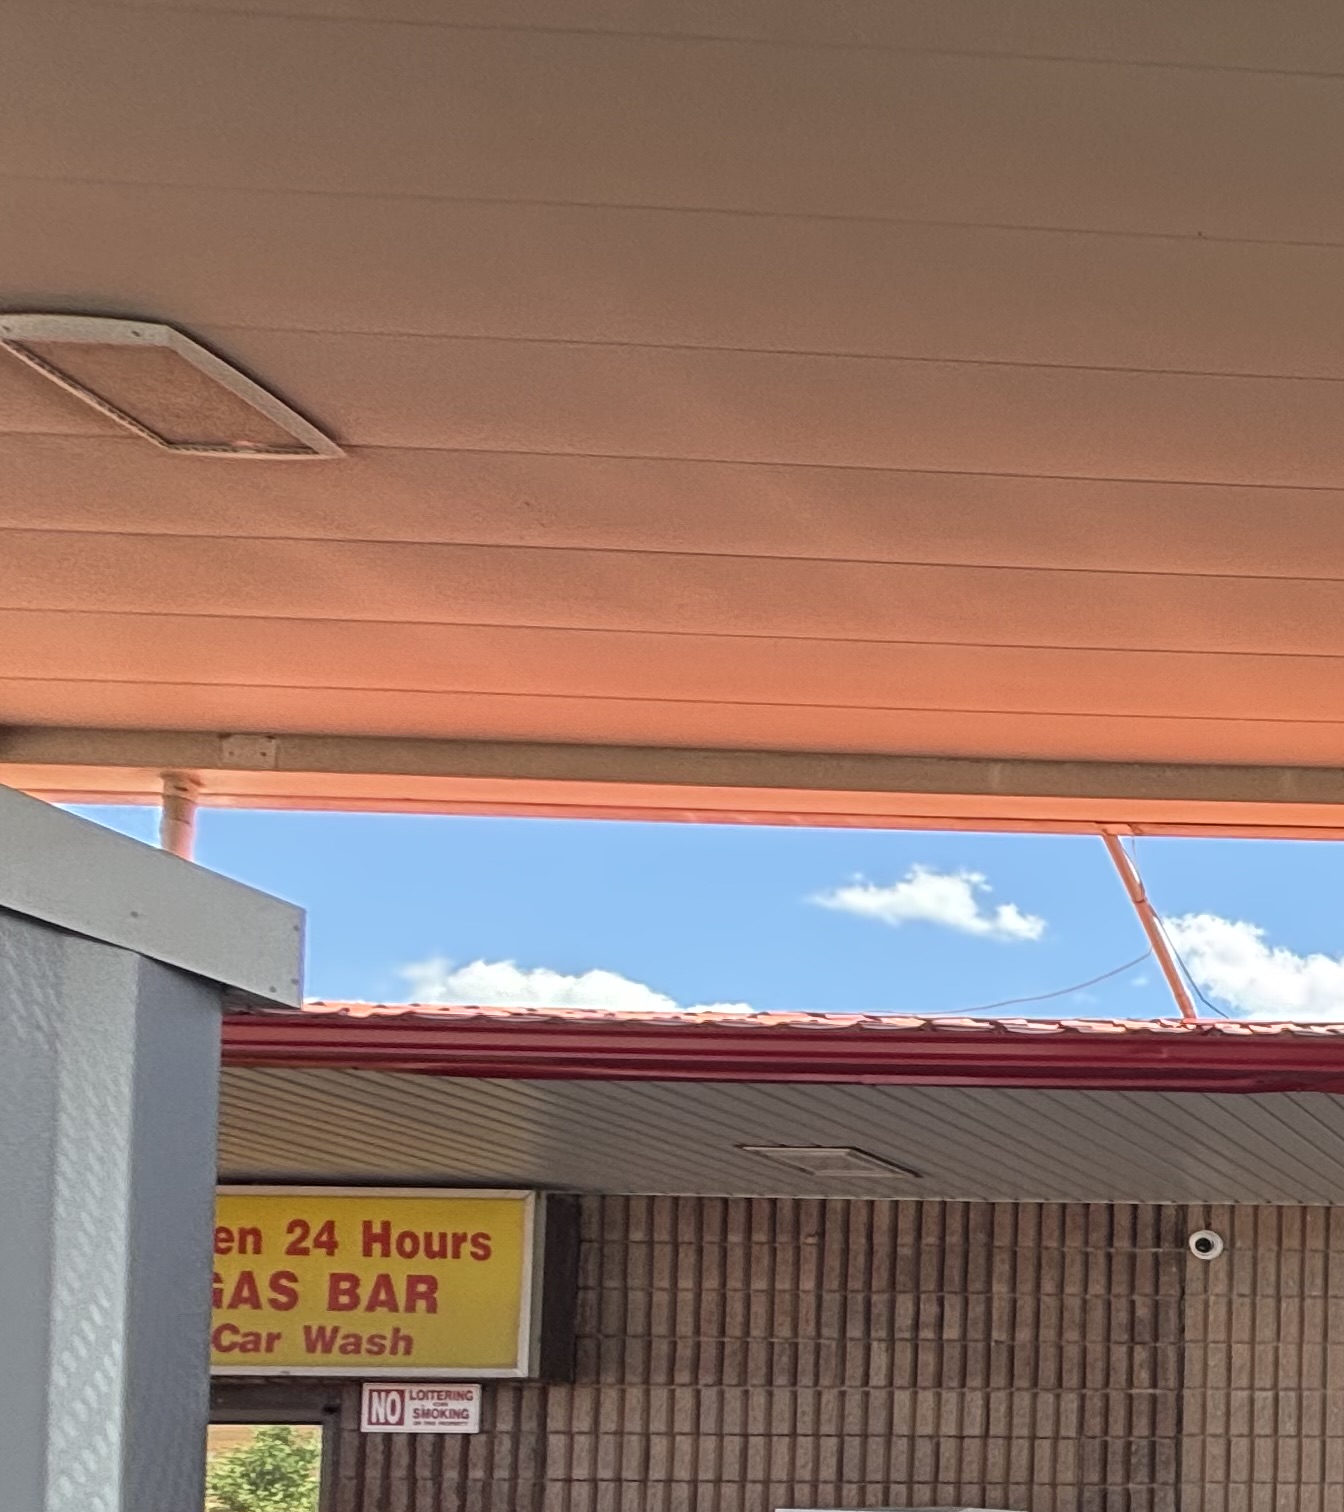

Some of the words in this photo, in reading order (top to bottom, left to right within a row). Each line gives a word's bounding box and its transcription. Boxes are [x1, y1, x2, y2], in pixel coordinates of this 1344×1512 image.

[213, 1226, 263, 1255] en
[285, 1218, 339, 1256] 24
[361, 1219, 492, 1261] Hours
[326, 1272, 438, 1314] BAR
[211, 1323, 282, 1353] Car
[303, 1324, 414, 1356] Wash
[370, 1391, 402, 1424] NO
[409, 1389, 474, 1401] LOITERING
[412, 1408, 470, 1419] SMOKING
